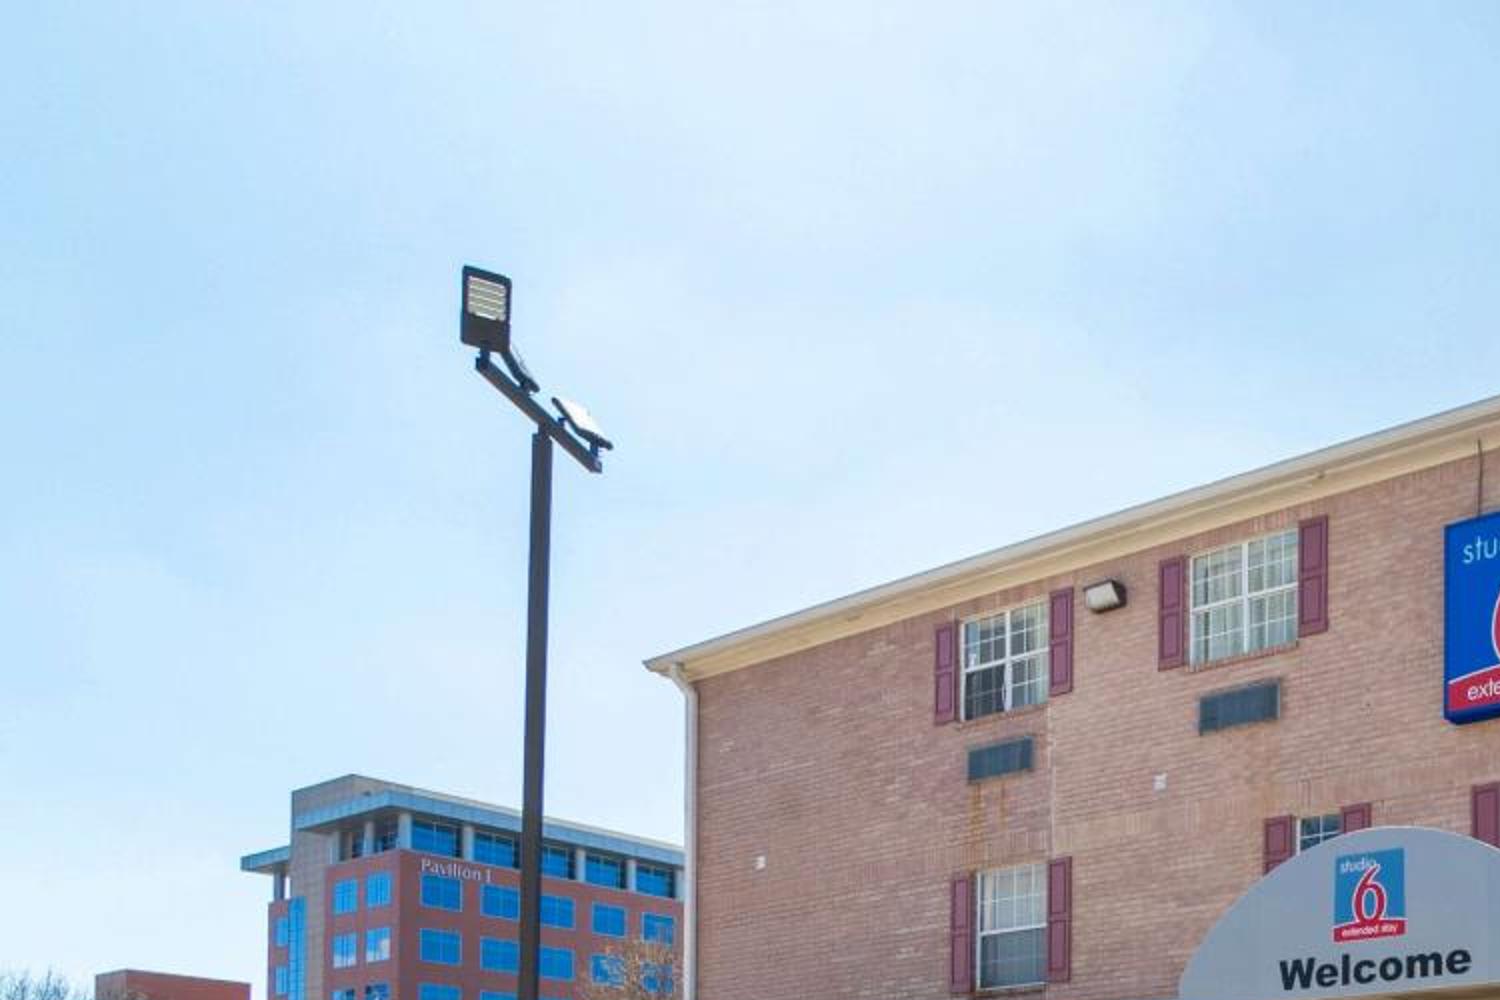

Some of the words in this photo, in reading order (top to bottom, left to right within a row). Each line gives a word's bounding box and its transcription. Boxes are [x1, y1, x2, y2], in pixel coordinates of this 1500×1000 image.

[421, 857, 481, 881] Pavilion
[1340, 857, 1377, 874] studio
[1351, 863, 1387, 921] 6
[1280, 949, 1472, 991] Welcome
